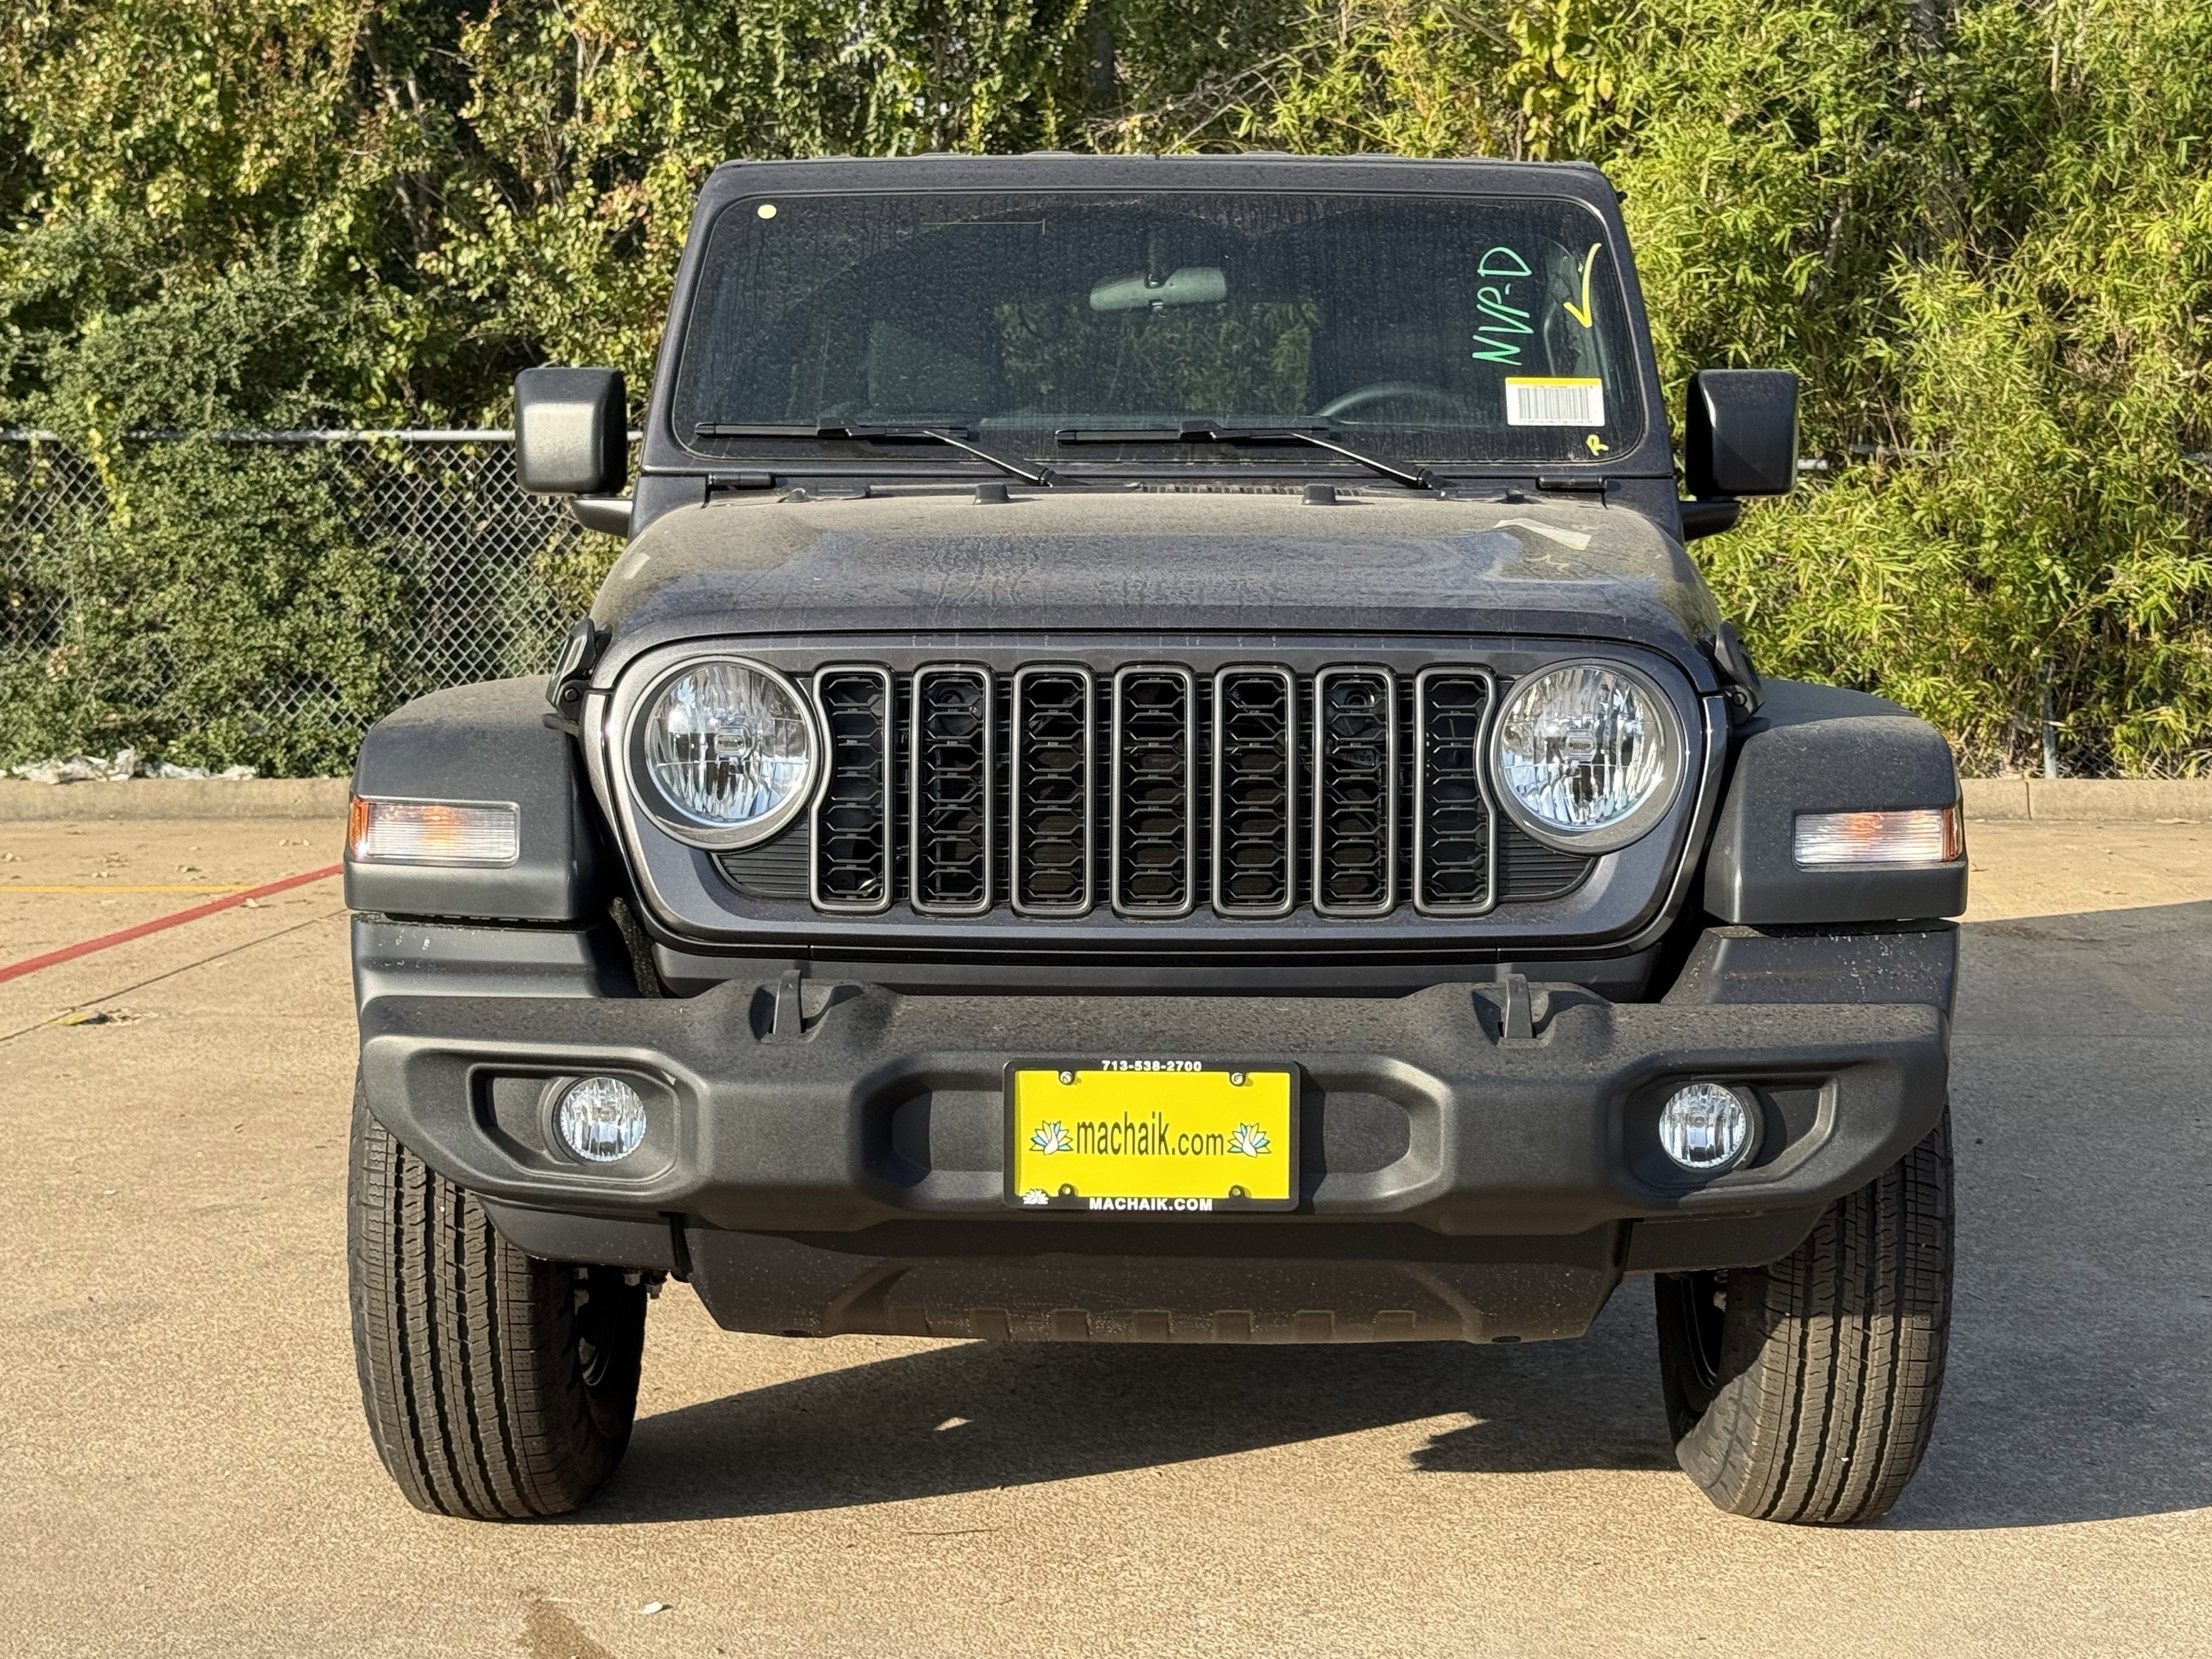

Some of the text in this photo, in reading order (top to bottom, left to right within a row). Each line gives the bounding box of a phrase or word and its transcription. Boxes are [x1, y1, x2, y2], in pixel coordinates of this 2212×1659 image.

[1102, 1059, 1202, 1071] 713-538-2700
[1076, 1111, 1224, 1155] machaik.com
[1089, 1197, 1213, 1211] MACHAIK.COM
